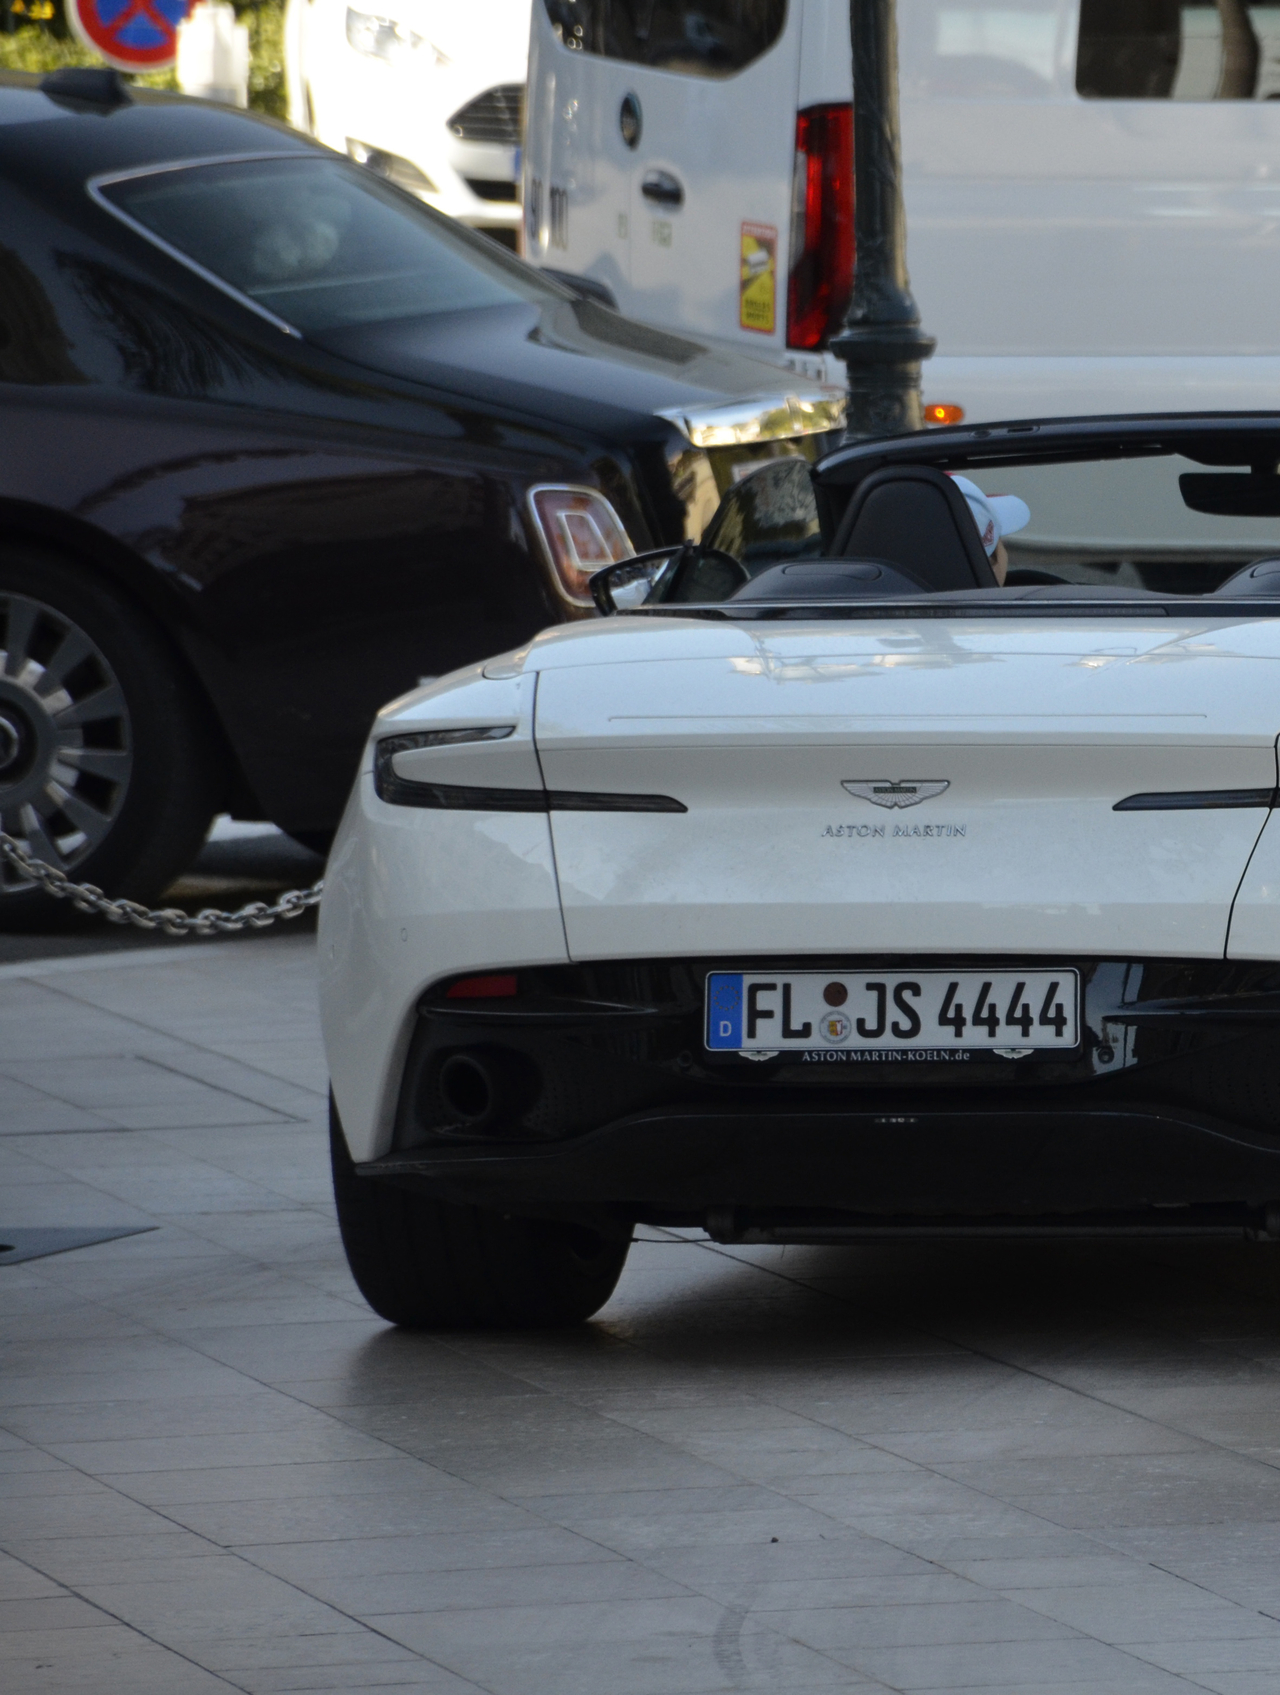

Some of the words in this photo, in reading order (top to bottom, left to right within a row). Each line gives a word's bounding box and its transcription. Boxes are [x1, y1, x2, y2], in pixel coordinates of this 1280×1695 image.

[821, 824, 886, 838] ASTON
[892, 823, 967, 837] MARTIN
[746, 982, 812, 1039] FL
[856, 981, 922, 1040] JS
[938, 981, 1068, 1038] 4444
[719, 1020, 732, 1037] D
[802, 1051, 847, 1062] ASTON
[850, 1049, 970, 1061] MARTIN-KOELN.de
